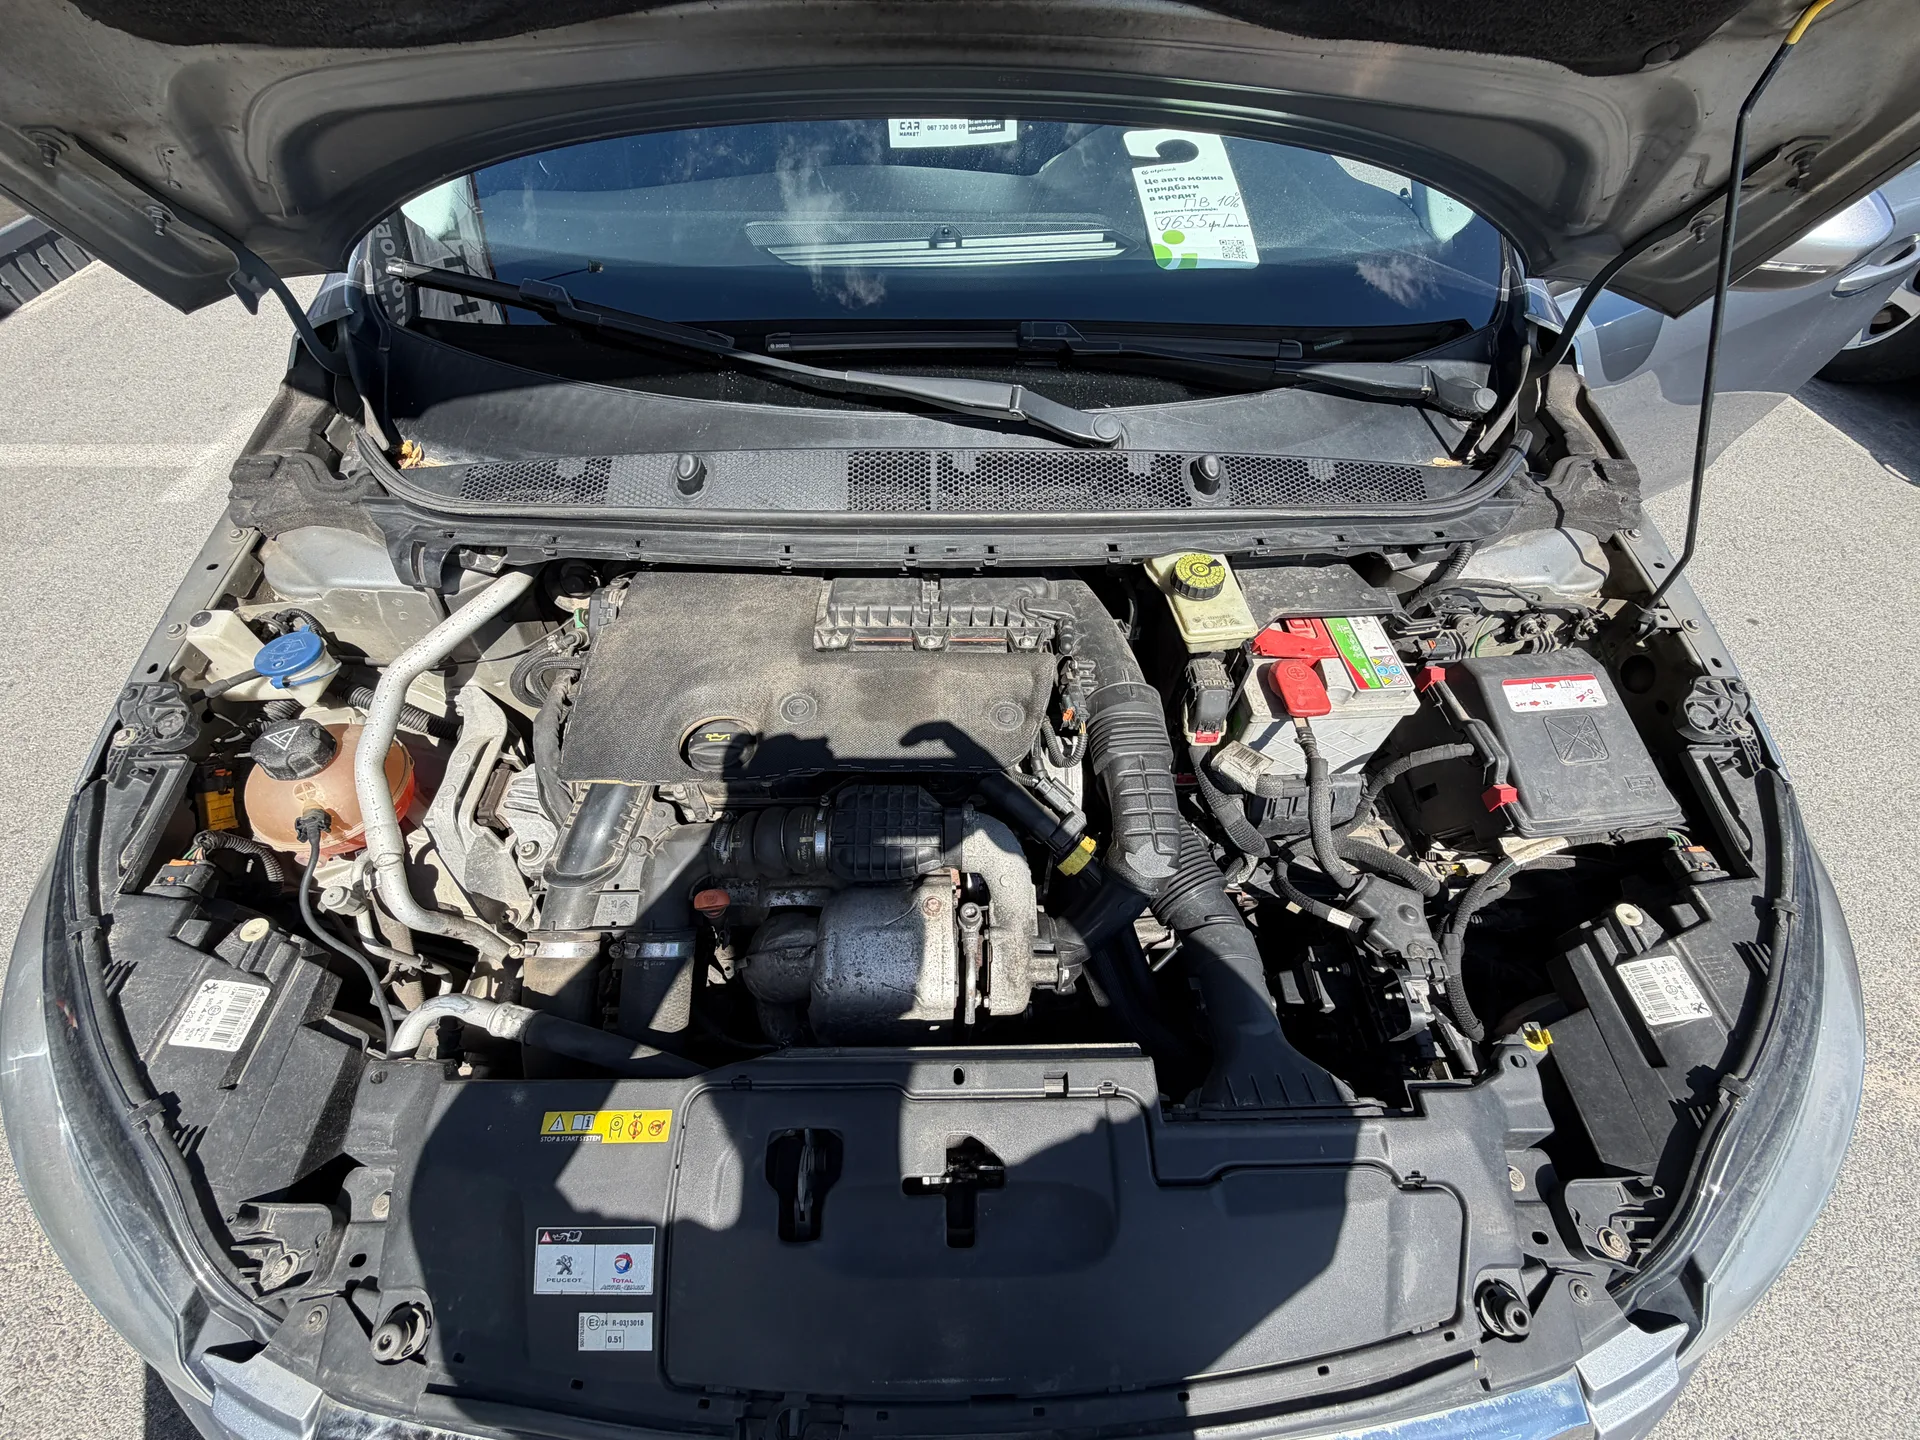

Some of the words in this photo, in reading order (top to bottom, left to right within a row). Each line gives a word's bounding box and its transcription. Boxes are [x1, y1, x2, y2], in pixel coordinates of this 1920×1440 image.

[899, 121, 920, 130] CAR
[1146, 184, 1200, 194] придбати
[1158, 193, 1197, 201] кредит
[600, 1319, 608, 1327] 24
[607, 1335, 622, 1344] 0.51
